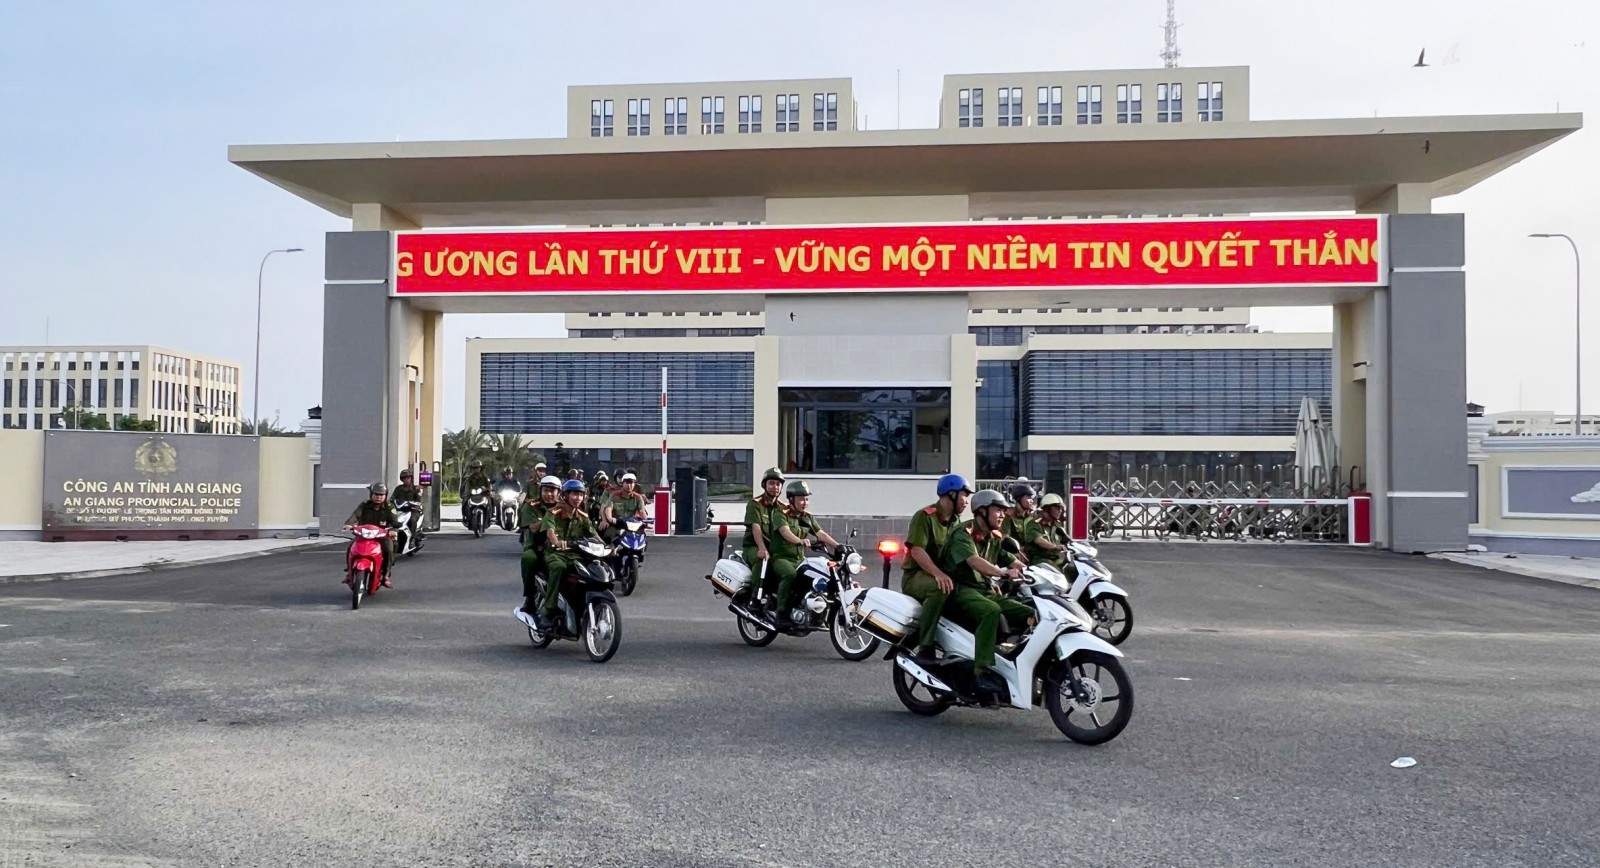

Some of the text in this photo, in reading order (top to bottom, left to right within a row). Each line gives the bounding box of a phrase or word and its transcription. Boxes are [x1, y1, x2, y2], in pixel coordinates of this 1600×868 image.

[424, 248, 518, 277] ƯƠNG
[529, 241, 589, 276] LẦN
[599, 241, 669, 275] THỨ
[676, 249, 742, 274] VIII
[775, 239, 871, 273] VỮNG
[883, 236, 957, 277] MỘT
[968, 234, 1057, 270] NIỀM
[1068, 242, 1130, 269] TIN
[1142, 231, 1261, 274] QUYẾT
[63, 478, 242, 494] CÔNG AN TỈNH AN GIANG
[63, 497, 241, 507] AN GIANG PROVINCIAL POLICE
